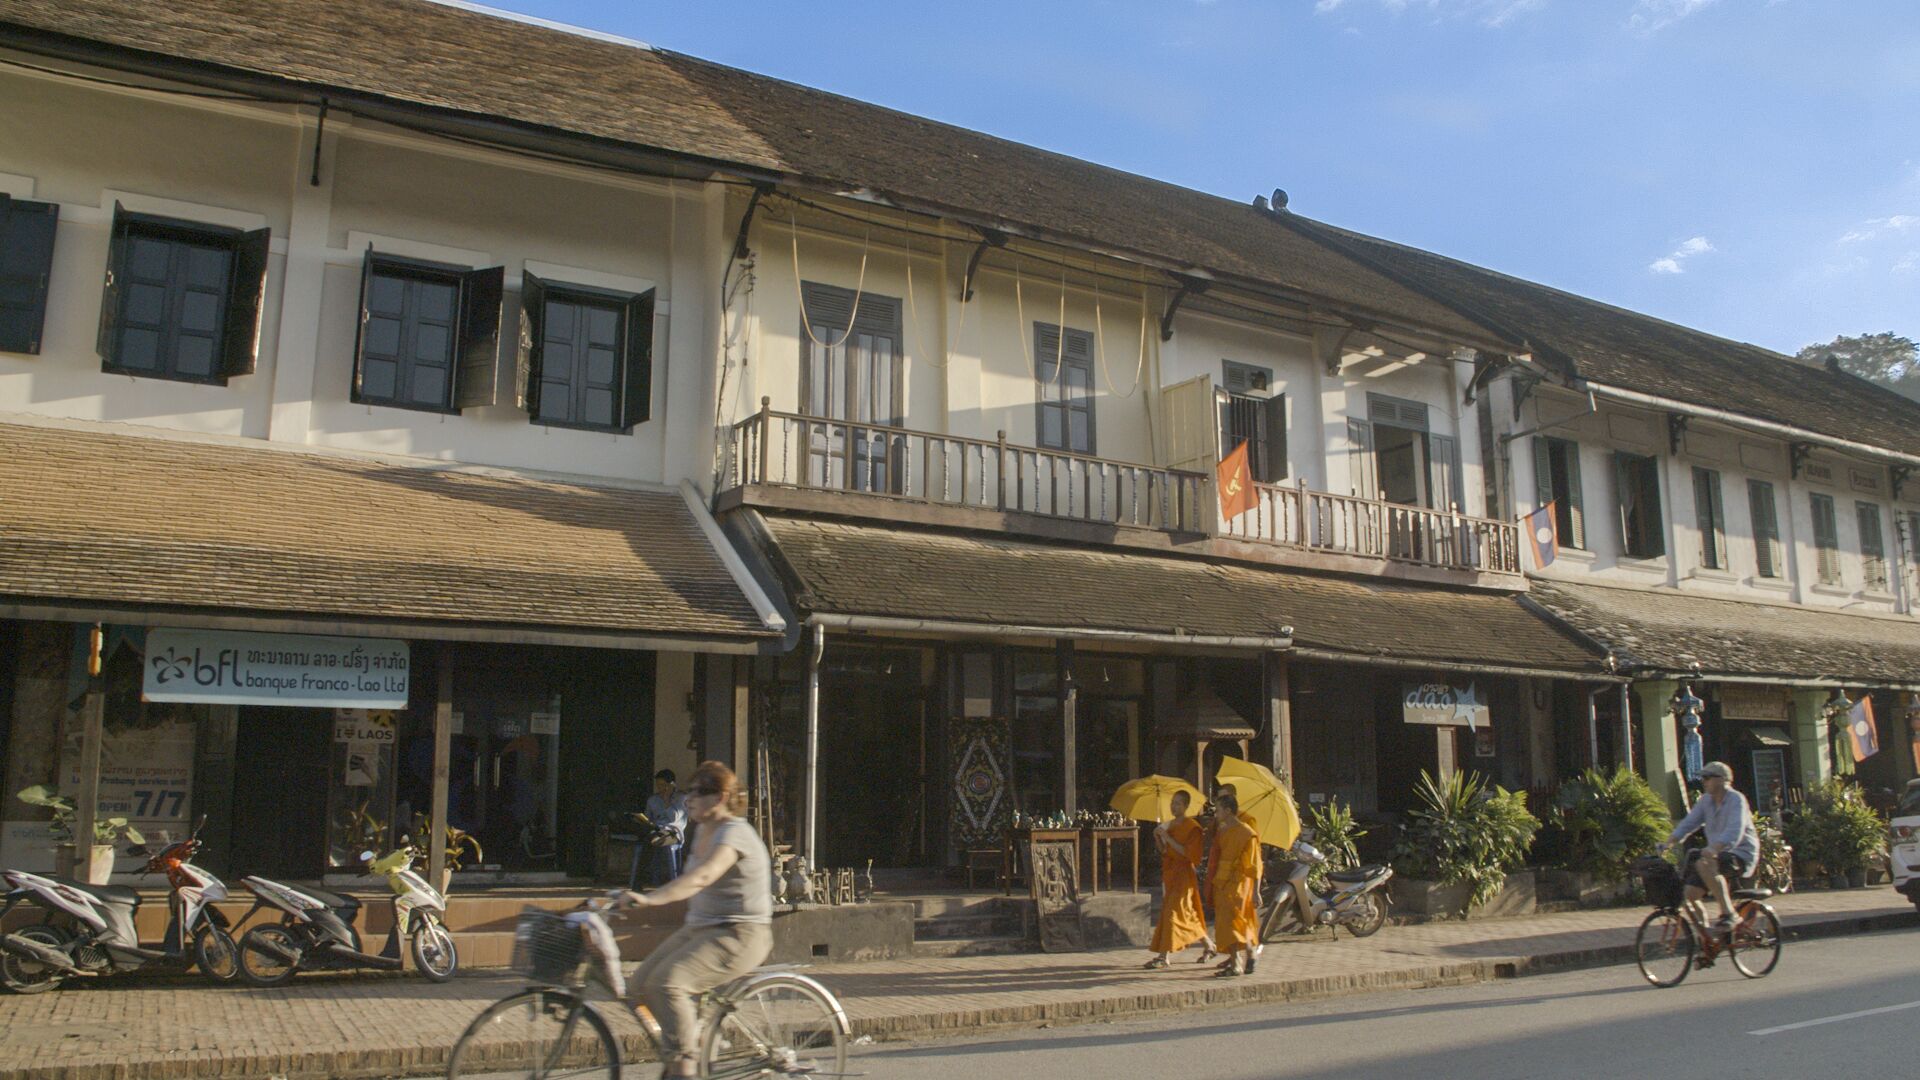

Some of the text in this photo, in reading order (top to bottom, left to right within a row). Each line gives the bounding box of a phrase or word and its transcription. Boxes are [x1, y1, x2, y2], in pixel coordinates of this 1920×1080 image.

[193, 647, 243, 687] bfl
[246, 670, 297, 694] banque
[358, 730, 393, 740] LAOS
[99, 802, 132, 813] OPEN!
[134, 790, 186, 816] 7/7
